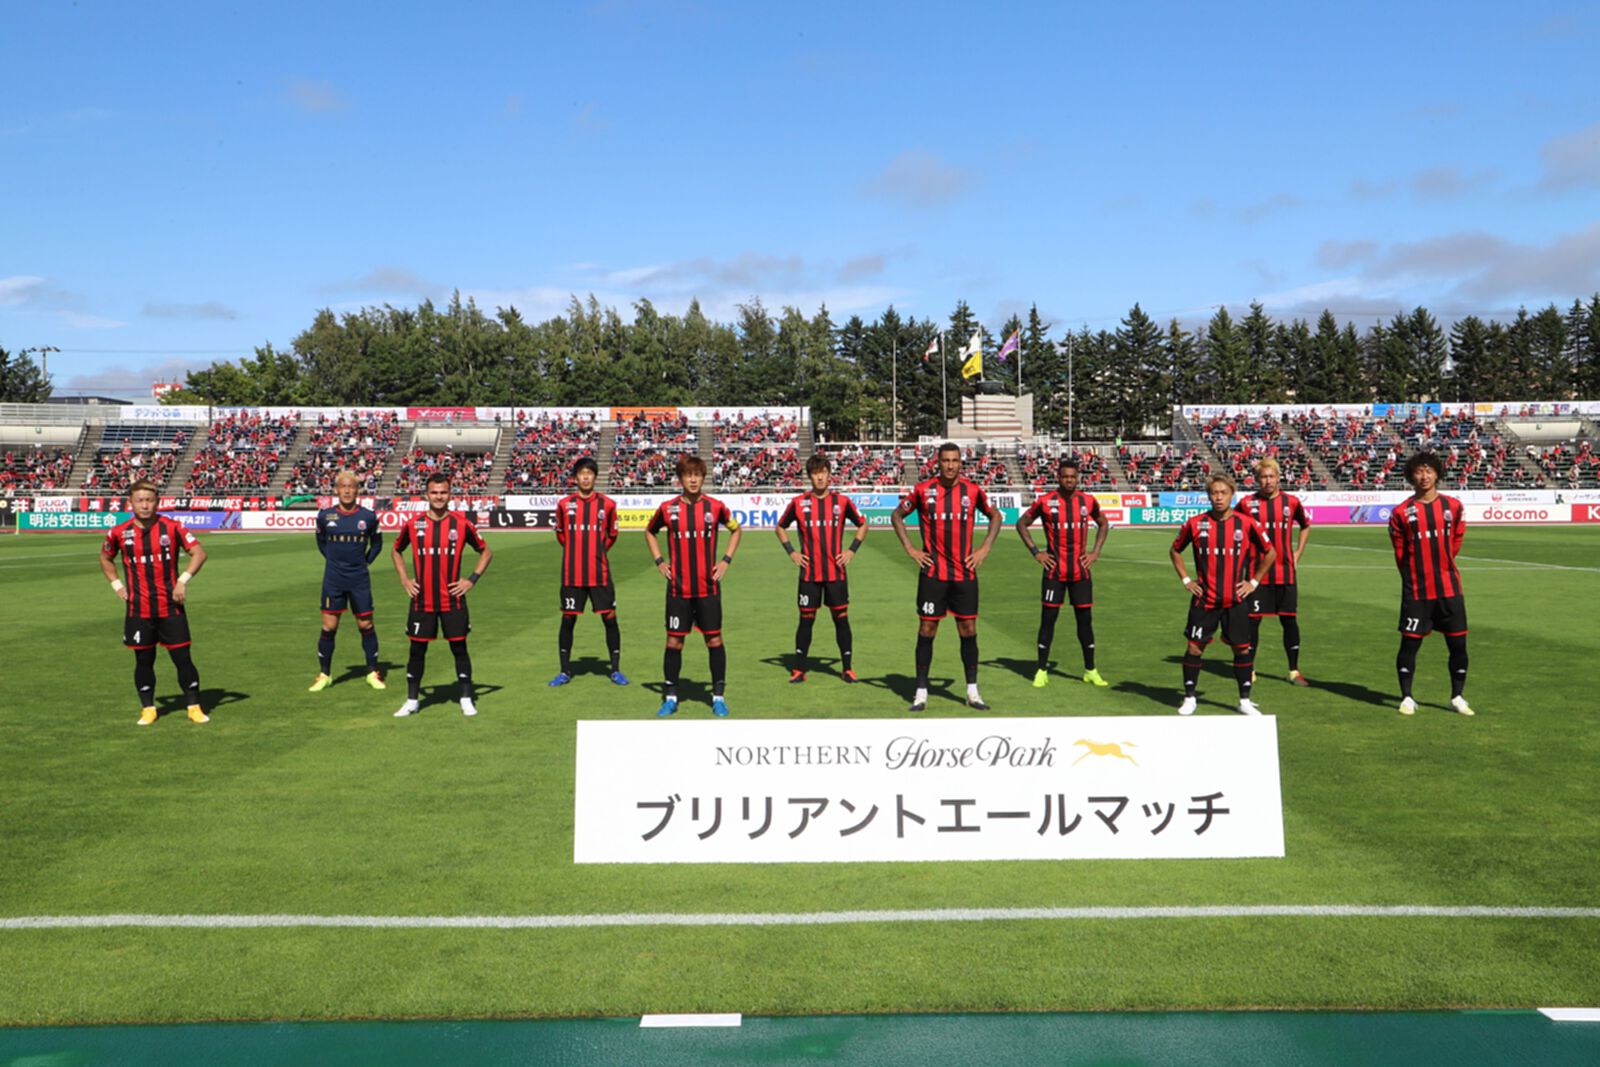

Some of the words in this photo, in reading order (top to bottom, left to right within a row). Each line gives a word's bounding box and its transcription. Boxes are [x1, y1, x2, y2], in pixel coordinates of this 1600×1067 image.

[188, 498, 243, 509] FERNANDES
[29, 513, 117, 527] 明治安田生命
[1482, 506, 1549, 520] docomo
[565, 597, 576, 609] 32
[922, 601, 935, 614] 48
[1254, 600, 1260, 612] 5
[413, 622, 420, 635] 7
[669, 616, 680, 630] 10
[1405, 617, 1420, 632] 27
[133, 630, 141, 644] 4
[1191, 626, 1203, 639] 14
[715, 745, 872, 766] NORTHERN
[885, 736, 974, 769] Horse
[975, 735, 1057, 769] Park
[637, 792, 1230, 841] ブリリアントエールマッチ
